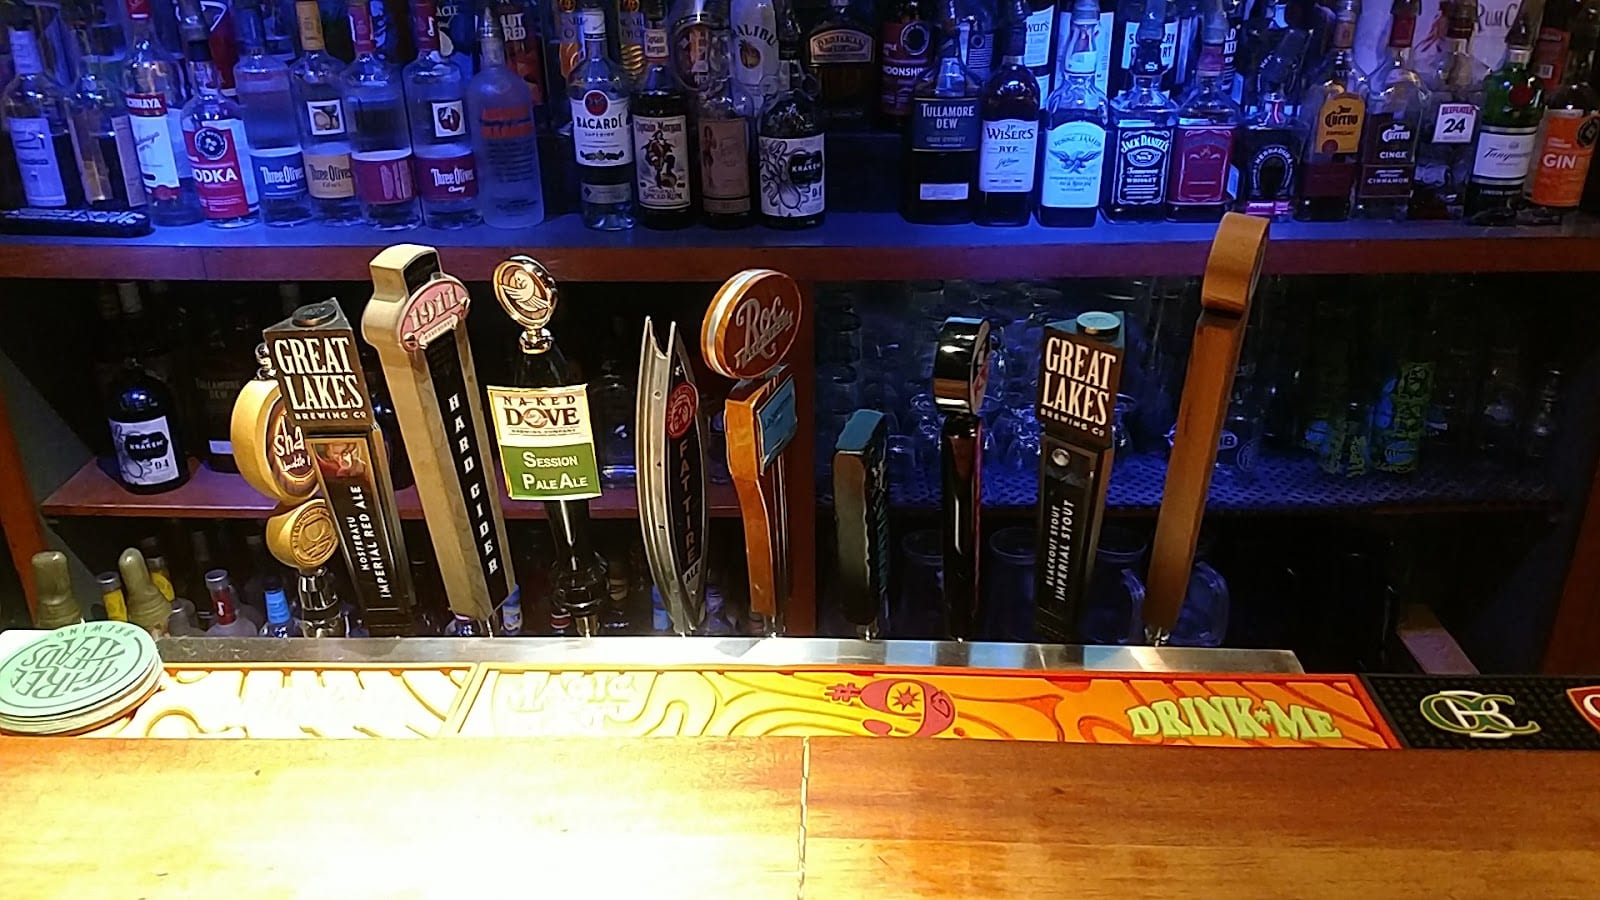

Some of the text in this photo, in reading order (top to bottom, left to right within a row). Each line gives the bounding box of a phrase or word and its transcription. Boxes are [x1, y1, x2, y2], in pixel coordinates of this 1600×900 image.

[504, 26, 526, 42] RED
[921, 103, 974, 118] TULLAMORE
[936, 117, 957, 129] DEW
[1443, 118, 1466, 134] 24
[1120, 136, 1139, 153] JACK
[1543, 153, 1576, 169] GIN
[430, 168, 454, 187] Three
[407, 286, 461, 332] 1911
[274, 337, 354, 376] GREAT
[1045, 336, 1117, 390] GREAT
[283, 374, 364, 411] LAKES
[502, 393, 577, 408] NAKED
[1041, 371, 1110, 426] LAKES
[294, 411, 367, 420] BREWING CO
[505, 407, 580, 430] DOVE
[1040, 407, 1105, 437] BREWING CO
[522, 450, 579, 468] SESSION
[448, 392, 499, 575] HARD CIDER
[522, 472, 590, 490] PALE ALE
[679, 438, 697, 564] FAT TIRE
[1050, 505, 1061, 537] STOUT
[346, 516, 371, 571] NOSFERATU
[350, 486, 392, 599] IMPERIAL RED ALE
[1055, 499, 1075, 601] IMPERIAL STOUT
[685, 564, 700, 585] ALE
[10, 659, 118, 700] THREE
